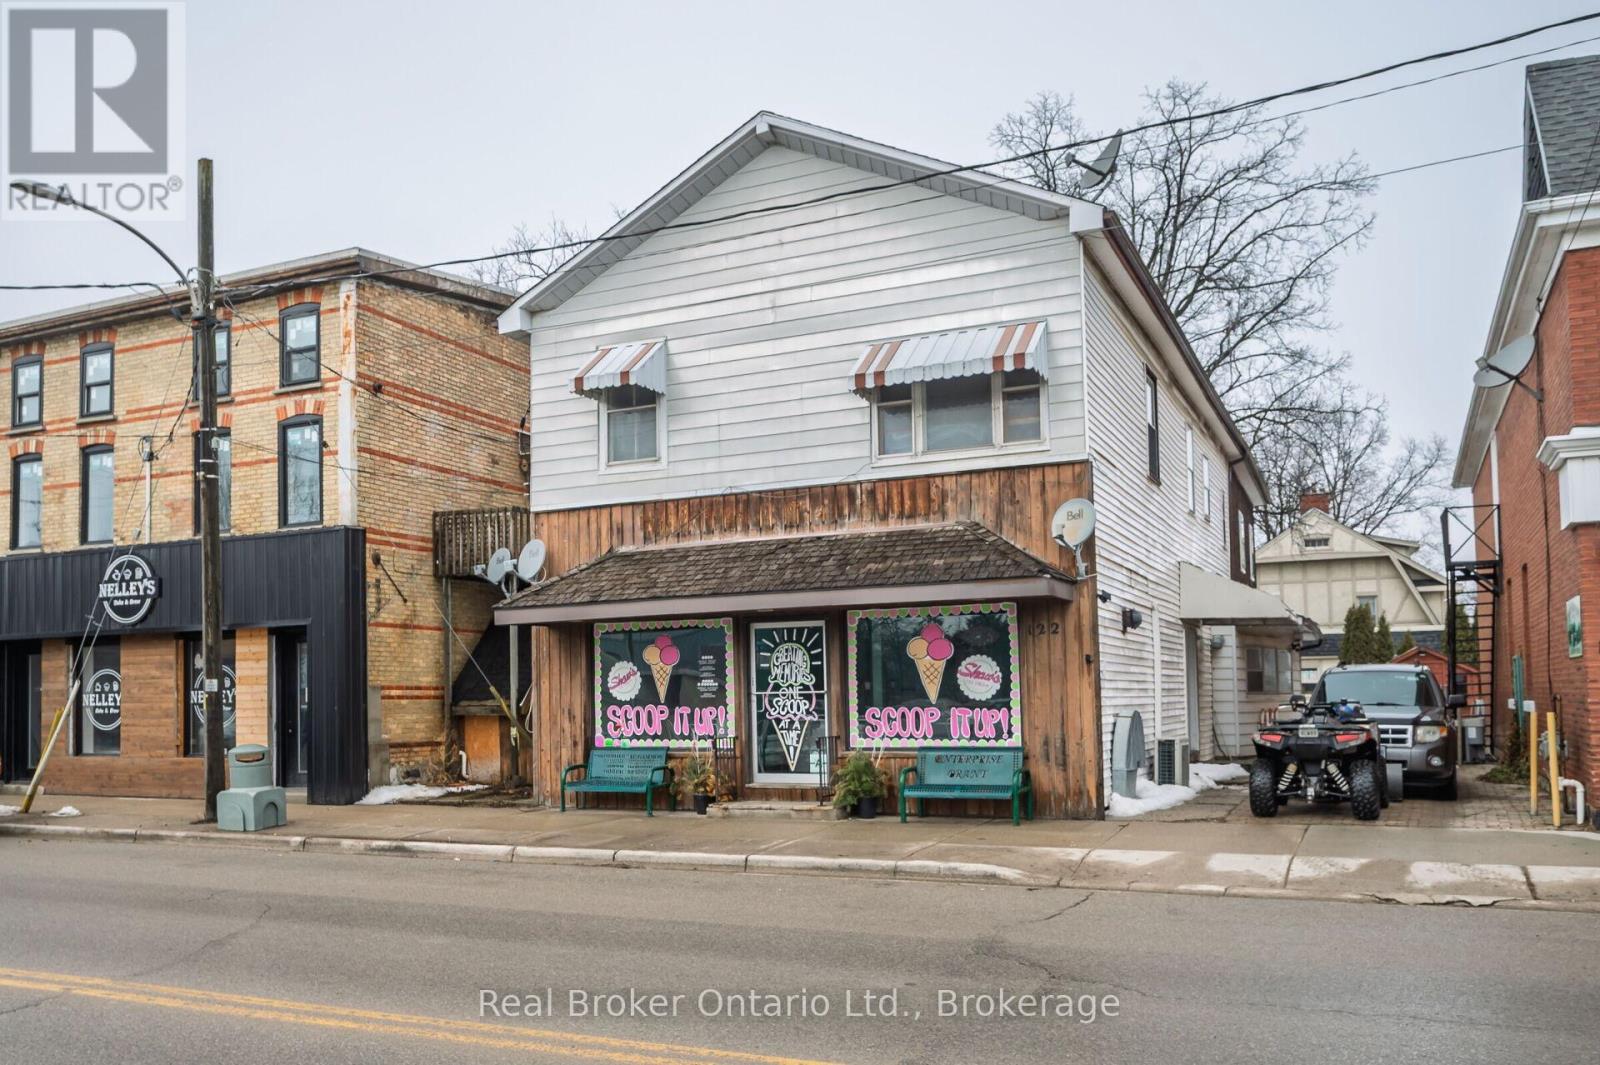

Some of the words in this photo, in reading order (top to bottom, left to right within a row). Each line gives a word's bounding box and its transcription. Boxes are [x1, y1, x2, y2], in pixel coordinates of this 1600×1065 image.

[1066, 508, 1084, 521] Bell
[98, 578, 156, 598] NELLEY'S
[1028, 622, 1060, 636] 122
[779, 686, 804, 700] ONE
[771, 698, 810, 716] SCOOP
[607, 704, 669, 738] SCOOP
[674, 706, 691, 736] IT
[694, 705, 726, 736] UP!
[779, 719, 791, 729] AT
[792, 719, 801, 730] A
[865, 706, 941, 738] SCOOP
[950, 706, 973, 738] IT
[974, 707, 1009, 739] UP!
